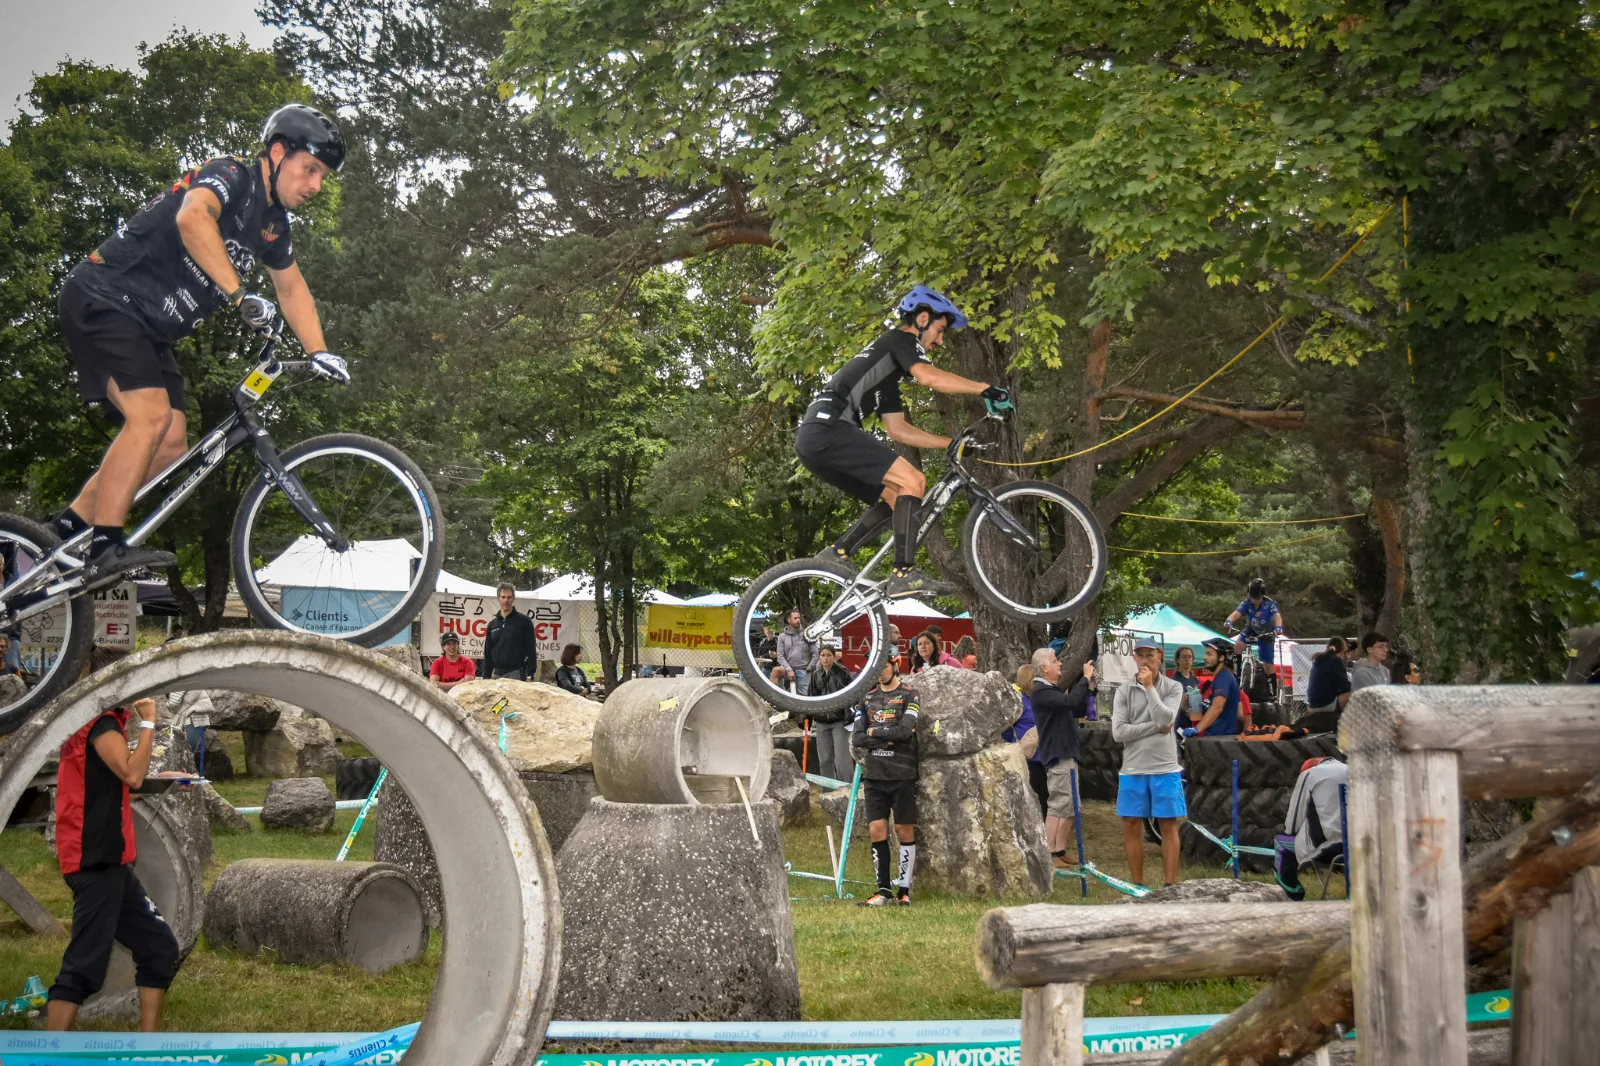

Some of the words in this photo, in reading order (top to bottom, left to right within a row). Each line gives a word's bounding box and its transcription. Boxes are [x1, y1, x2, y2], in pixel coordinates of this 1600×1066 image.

[183, 256, 210, 288] HANGAR
[253, 377, 263, 388] 5
[110, 588, 129, 601] SA
[96, 611, 130, 619] lectricité
[305, 610, 349, 622] Clientis
[305, 623, 327, 631] Caisse
[439, 616, 562, 641] HUGET
[649, 629, 733, 648] villatype.ch
[348, 1039, 388, 1059] Clientis
[1090, 1033, 1185, 1054] MOTOREX
[936, 1046, 1021, 1066] MOTORE
